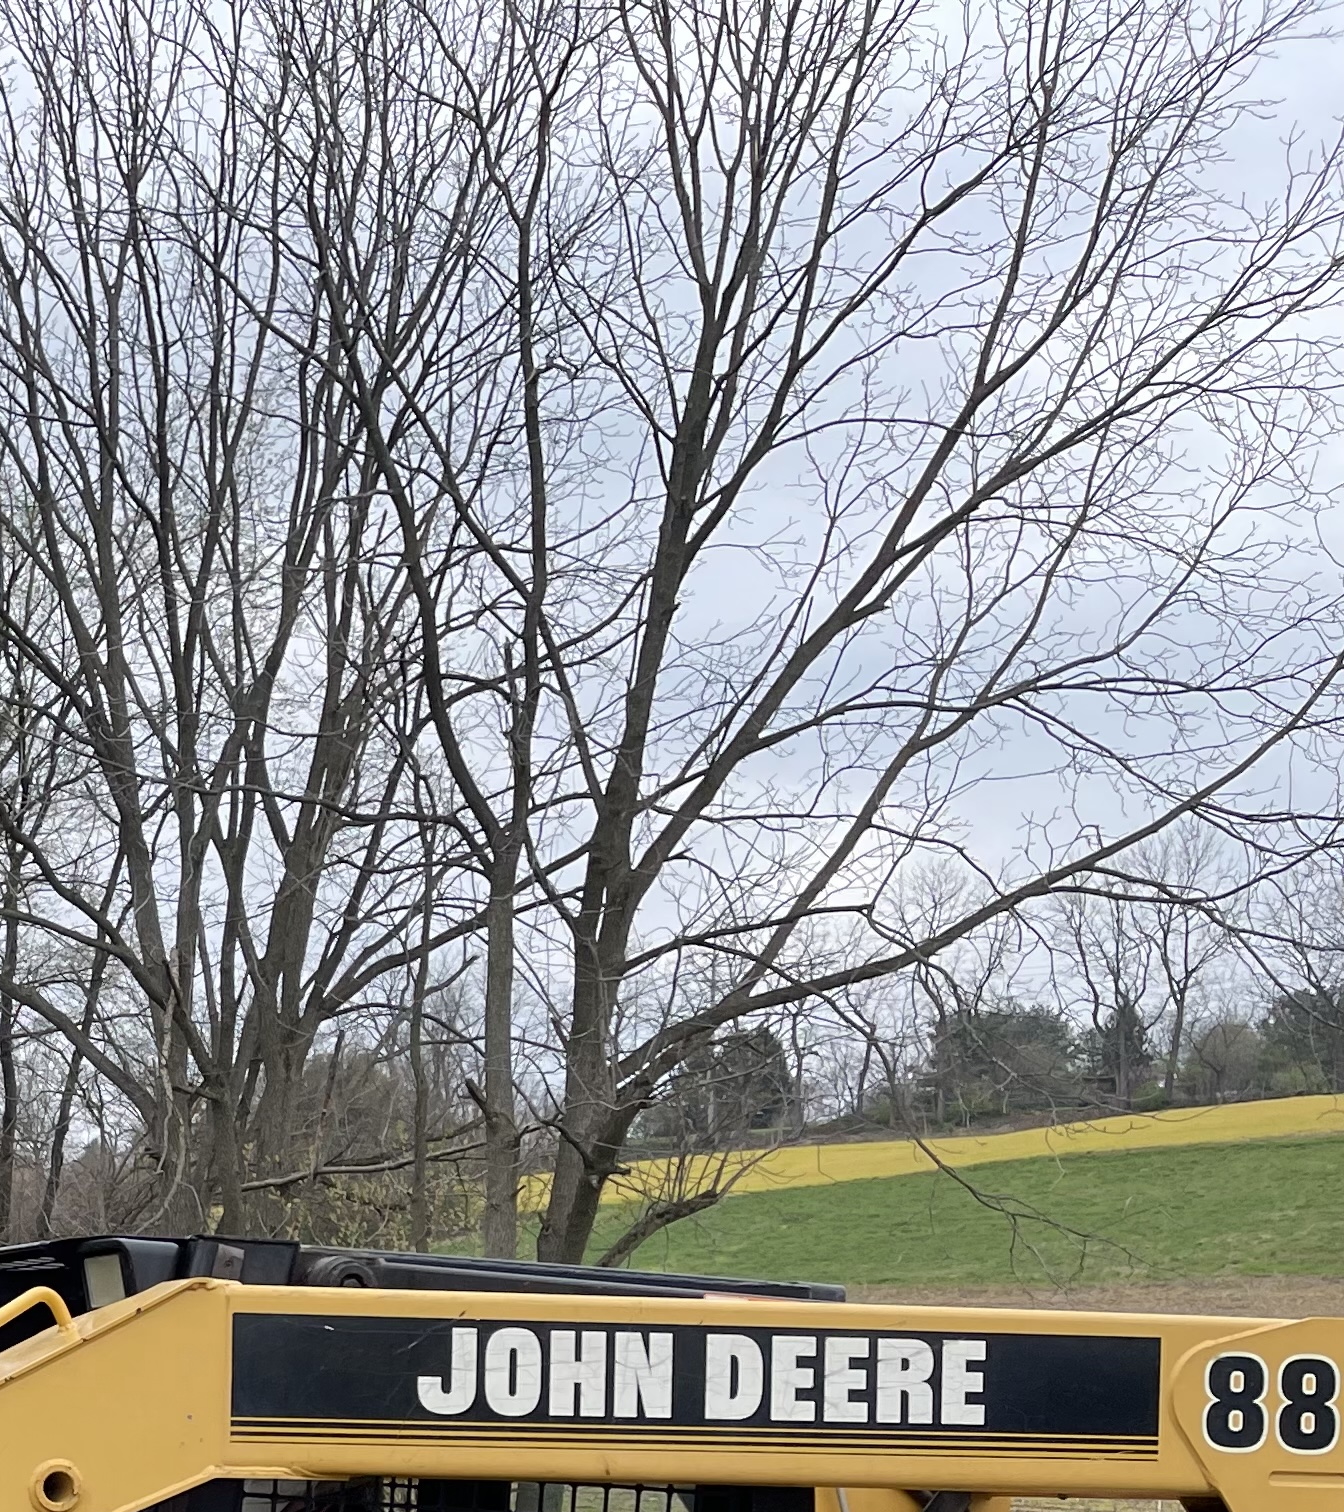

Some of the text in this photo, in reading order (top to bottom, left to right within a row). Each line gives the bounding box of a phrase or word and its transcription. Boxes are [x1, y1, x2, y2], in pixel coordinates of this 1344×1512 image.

[417, 1327, 987, 1426] JOHN DEERE
[1201, 1351, 1341, 1456] 88
